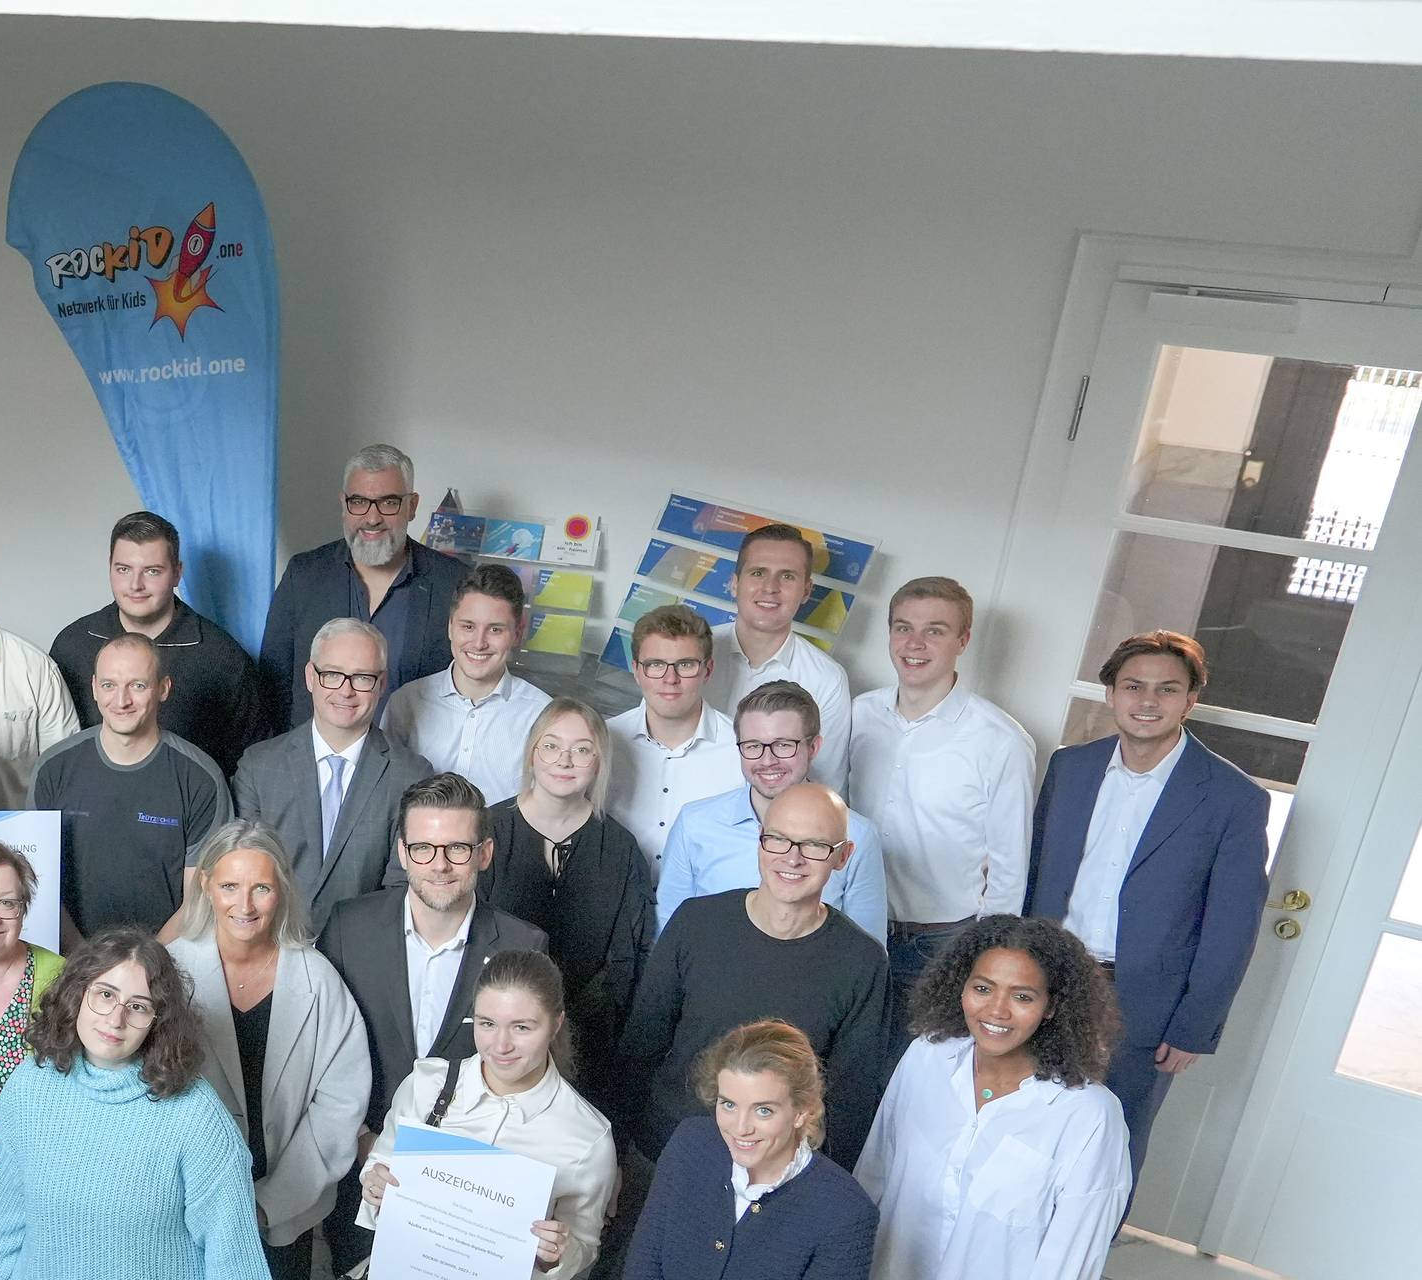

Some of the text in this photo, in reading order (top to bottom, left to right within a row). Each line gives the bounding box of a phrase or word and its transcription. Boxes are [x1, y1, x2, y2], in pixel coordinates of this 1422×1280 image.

[215, 242, 244, 259] .one
[57, 290, 147, 318] Netzwerk für Kids
[98, 356, 246, 385] www.rockid.one
[421, 1166, 516, 1208] AUSZEICHNUNG
